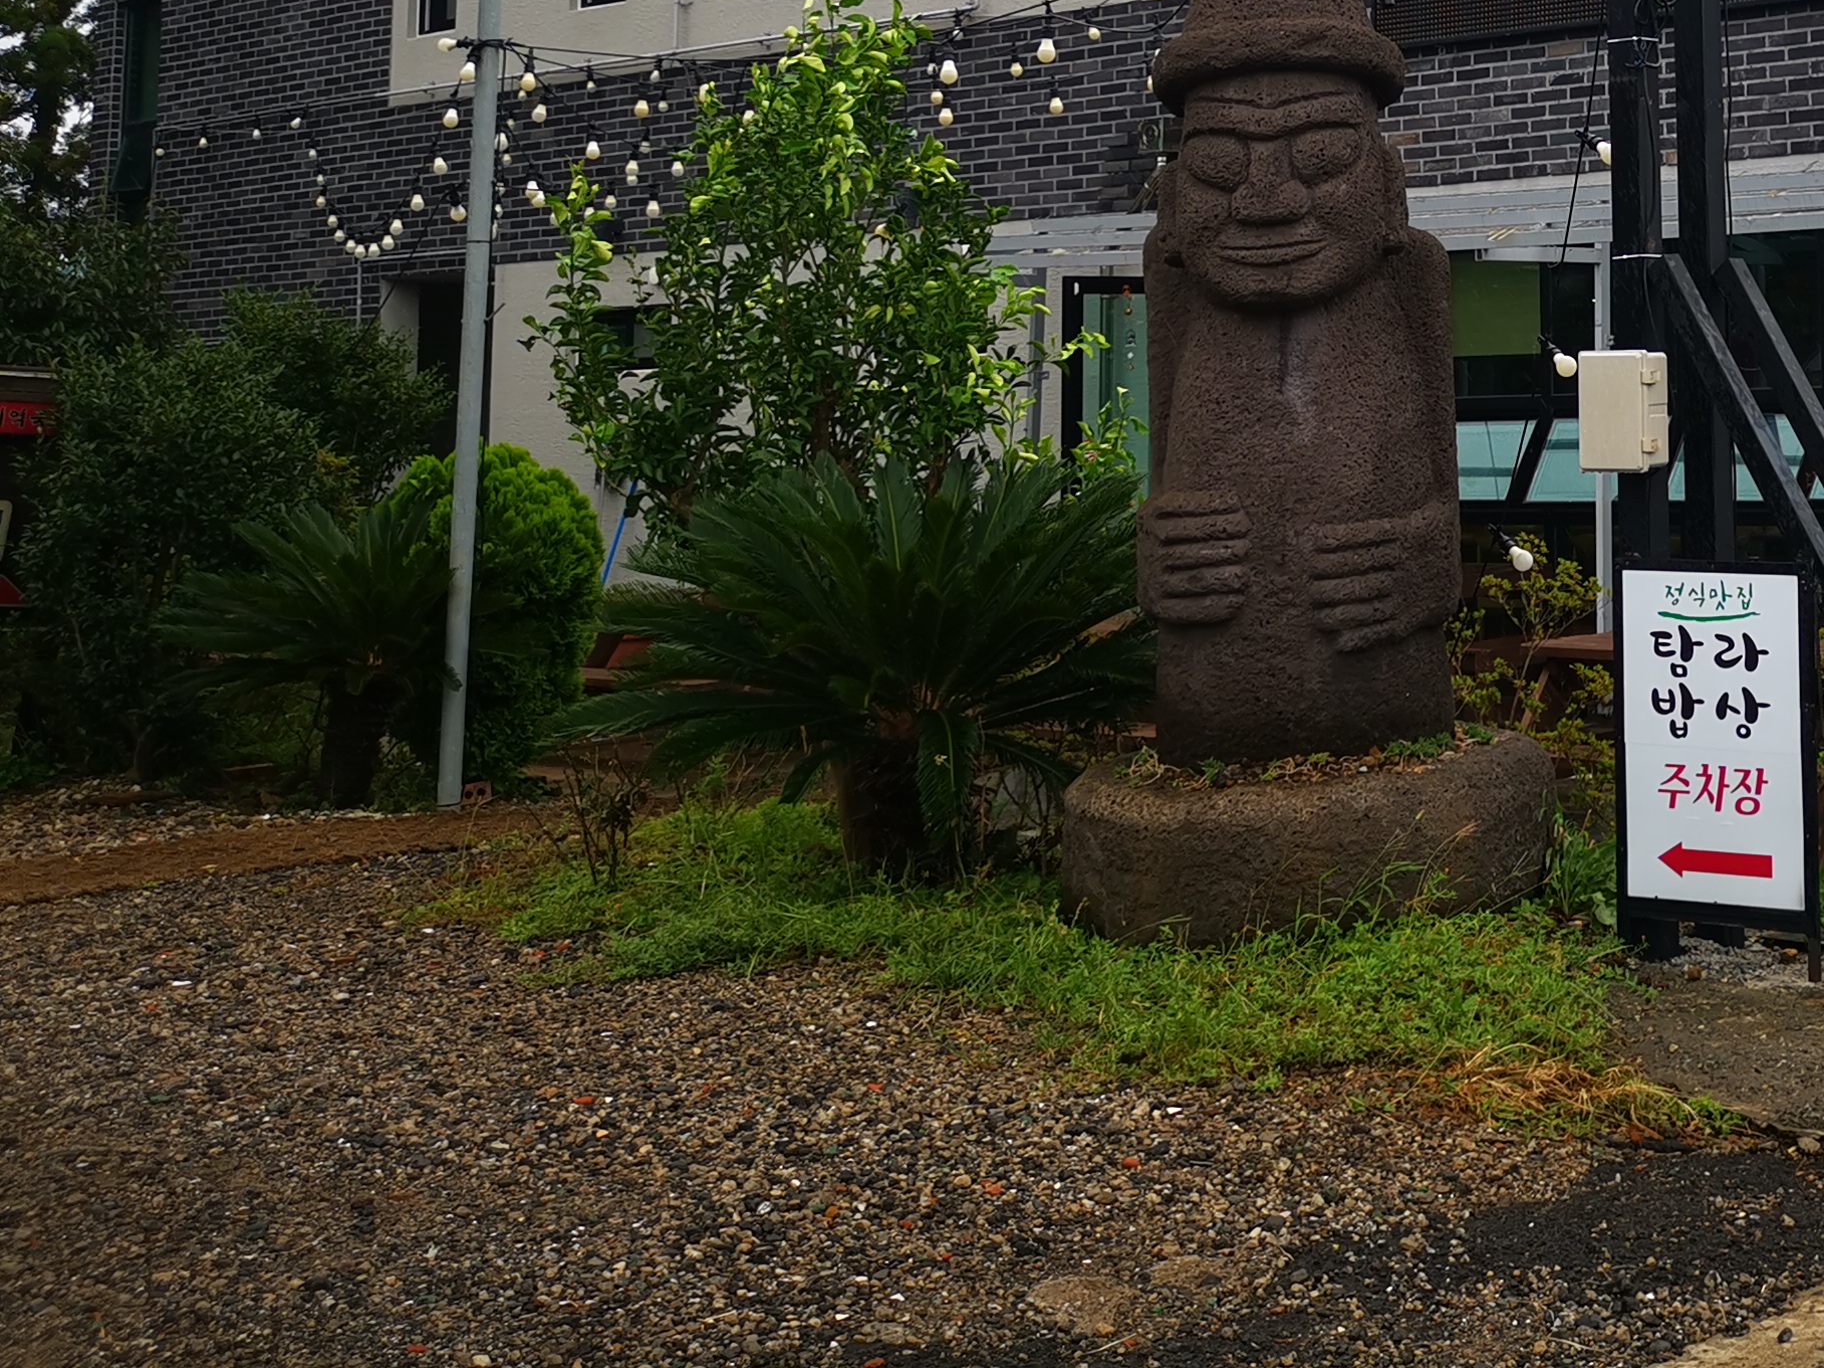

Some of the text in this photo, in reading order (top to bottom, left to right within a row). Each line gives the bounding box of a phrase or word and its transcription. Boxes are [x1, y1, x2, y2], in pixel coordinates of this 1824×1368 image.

[1664, 580, 1754, 612] 정식맛집
[1650, 624, 1770, 679] 탐라
[1651, 682, 1771, 740] 밥상
[1657, 763, 1769, 816] 주차장
